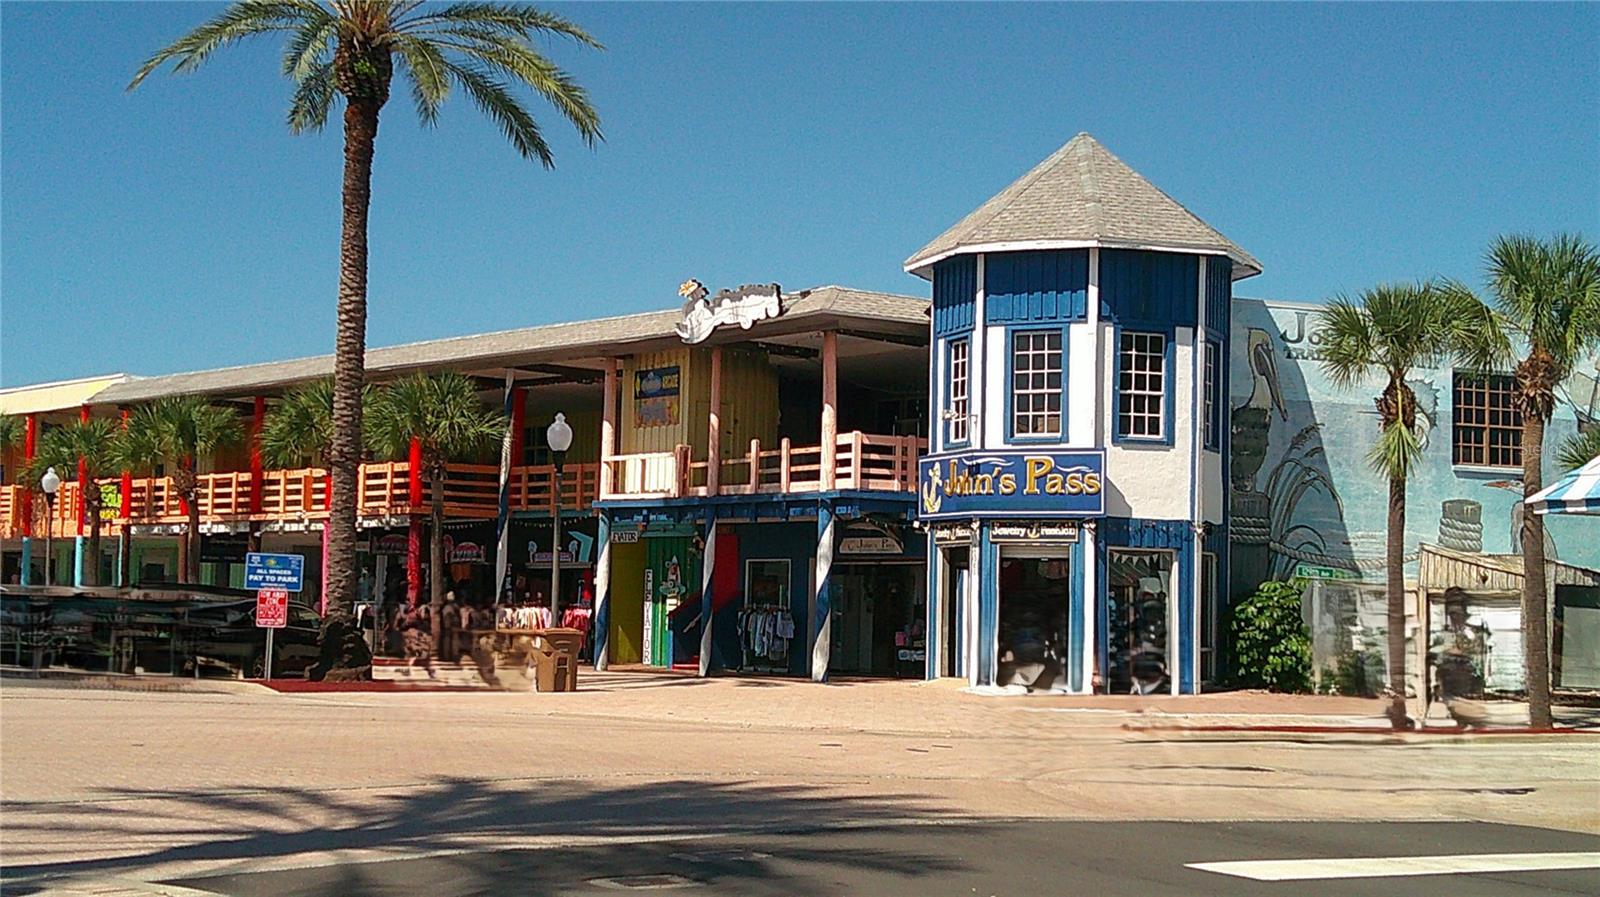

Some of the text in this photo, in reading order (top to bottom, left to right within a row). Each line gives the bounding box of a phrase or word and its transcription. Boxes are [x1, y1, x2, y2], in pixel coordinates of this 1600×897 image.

[943, 456, 1101, 496] John's Pass
[612, 532, 637, 542] EVATOR
[992, 527, 1026, 537] Jewelry
[248, 574, 264, 582] PAY
[643, 570, 653, 664] ELEVATOR
